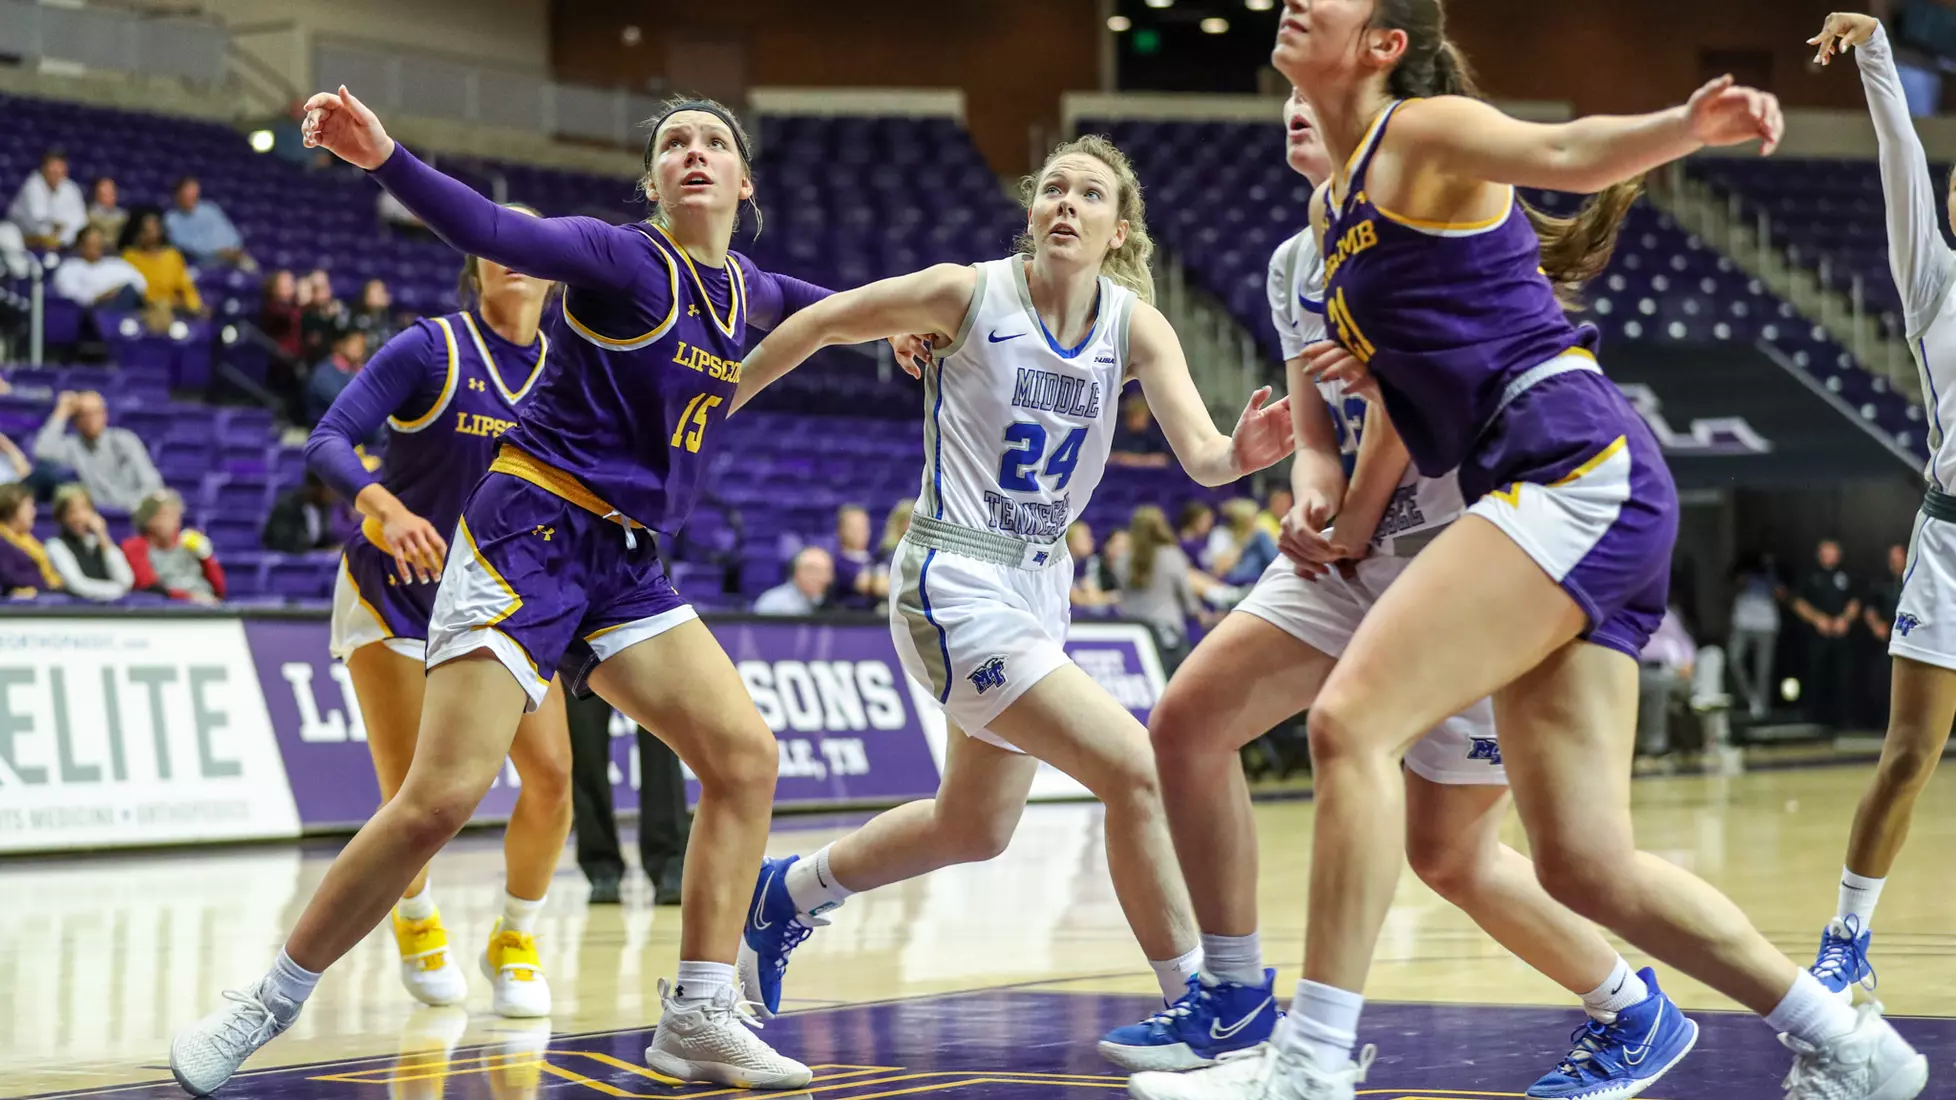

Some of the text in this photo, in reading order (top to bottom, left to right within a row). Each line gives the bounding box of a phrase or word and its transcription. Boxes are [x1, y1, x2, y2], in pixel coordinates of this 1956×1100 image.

[1012, 368, 1100, 418] MIDDLE
[455, 412, 518, 439] LIPS
[671, 393, 723, 453] 15
[999, 421, 1089, 493] 24
[967, 657, 1006, 695] MT
[0, 665, 243, 785] ELITE
[820, 738, 870, 776] TN
